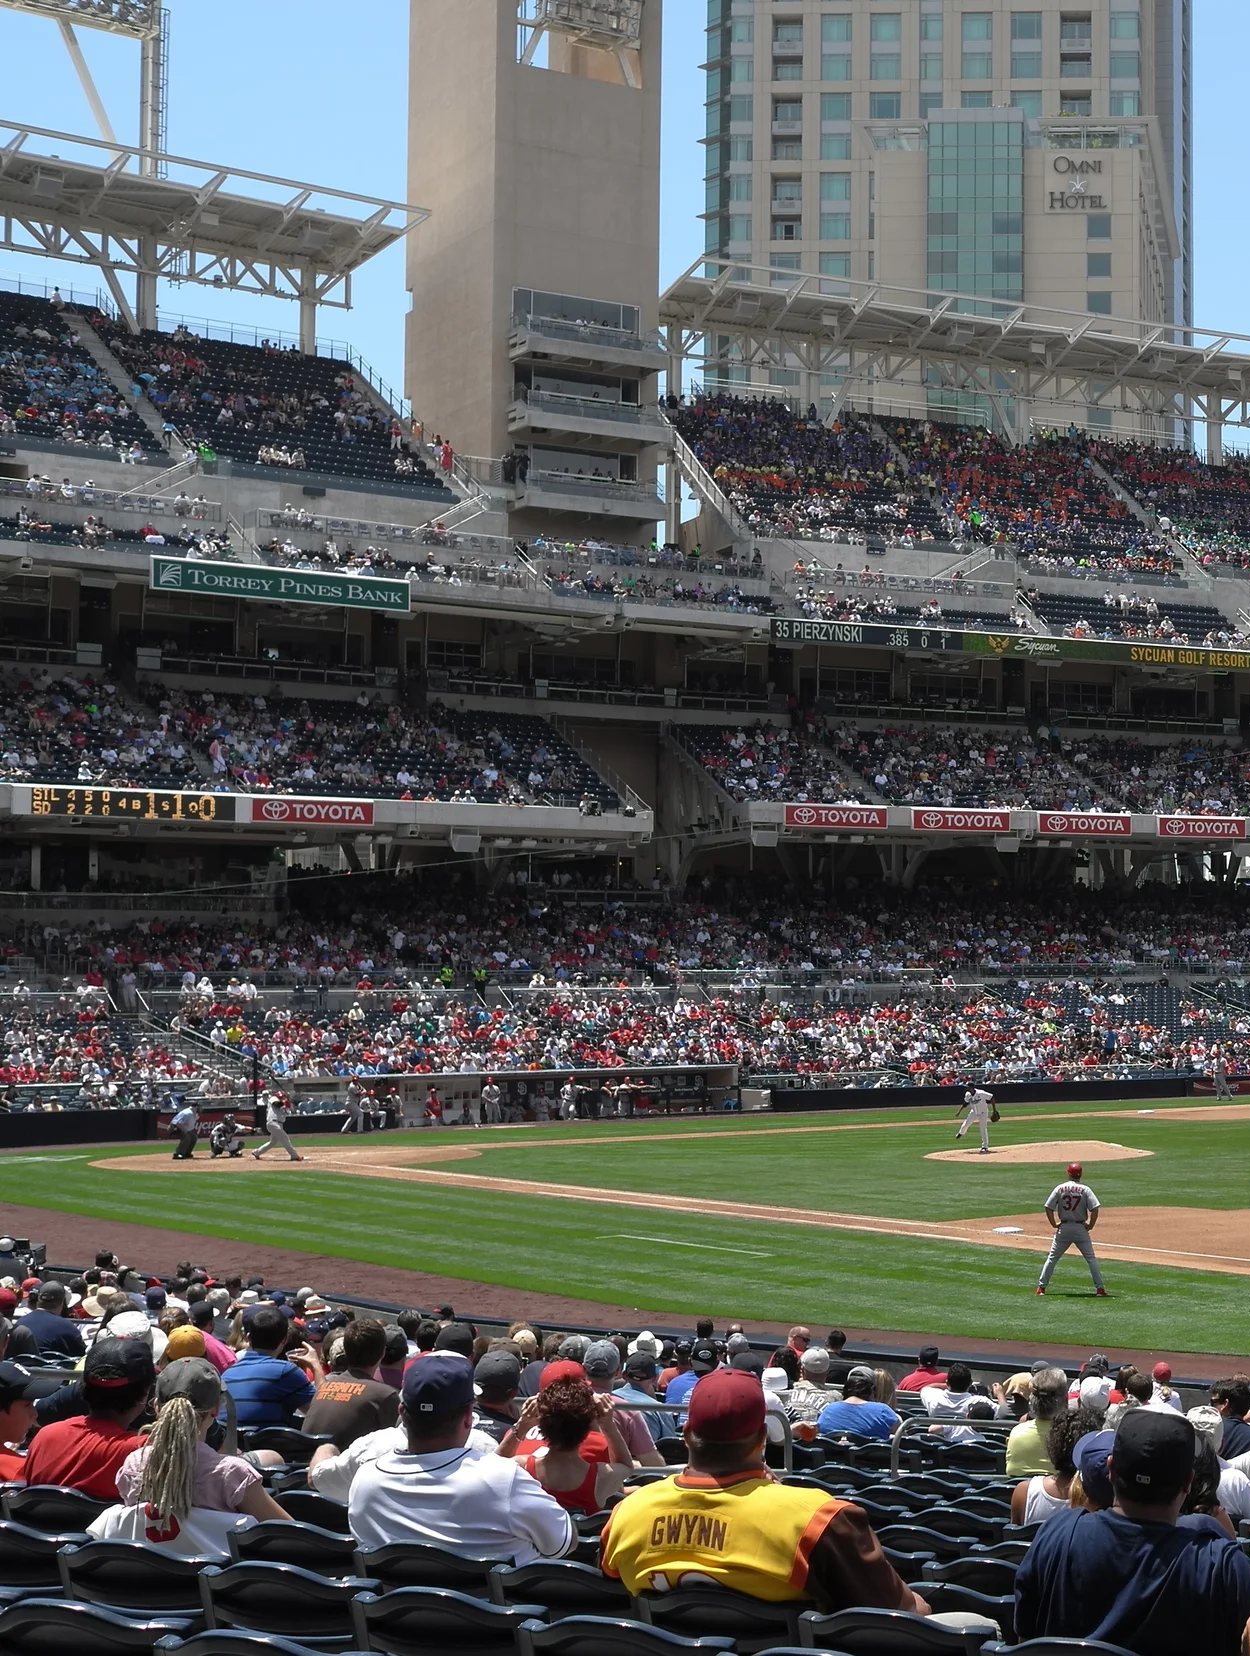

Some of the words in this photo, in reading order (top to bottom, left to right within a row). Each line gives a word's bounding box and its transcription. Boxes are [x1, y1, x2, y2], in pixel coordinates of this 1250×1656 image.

[1053, 155, 1102, 174] OMNI
[1048, 191, 1107, 209] HOTEL
[188, 569, 273, 591] TORREY
[279, 578, 342, 597] PINES
[346, 584, 403, 604] BANK
[775, 621, 789, 638] 35
[793, 623, 863, 643] PIERZYNSKI
[886, 633, 909, 647] .385
[921, 635, 928, 648] 0
[940, 637, 946, 649] 1
[1014, 637, 1060, 655] Sycuan
[1130, 647, 1175, 663] SYCUAN
[1178, 650, 1206, 665] GOLF
[1209, 652, 1250, 668] RESORT
[33, 787, 60, 801] STL
[67, 789, 76, 800] 4
[84, 790, 93, 801] 5
[102, 791, 110, 802] 0
[32, 801, 51, 815] SD
[67, 803, 75, 815] 2
[84, 804, 93, 815] 2
[118, 798, 127, 809] 4
[132, 799, 141, 810] B
[144, 792, 158, 819] 1
[172, 794, 186, 820] 1
[199, 795, 216, 821] 0
[292, 803, 365, 821] TOYOTA
[818, 809, 880, 824] TOYOTA
[945, 814, 1003, 828] TOYOTA
[1069, 817, 1125, 831] TOYOTA
[1187, 821, 1239, 835] TOYOTA
[1062, 1195, 1081, 1211] 37
[650, 1514, 728, 1551] GWYNN
